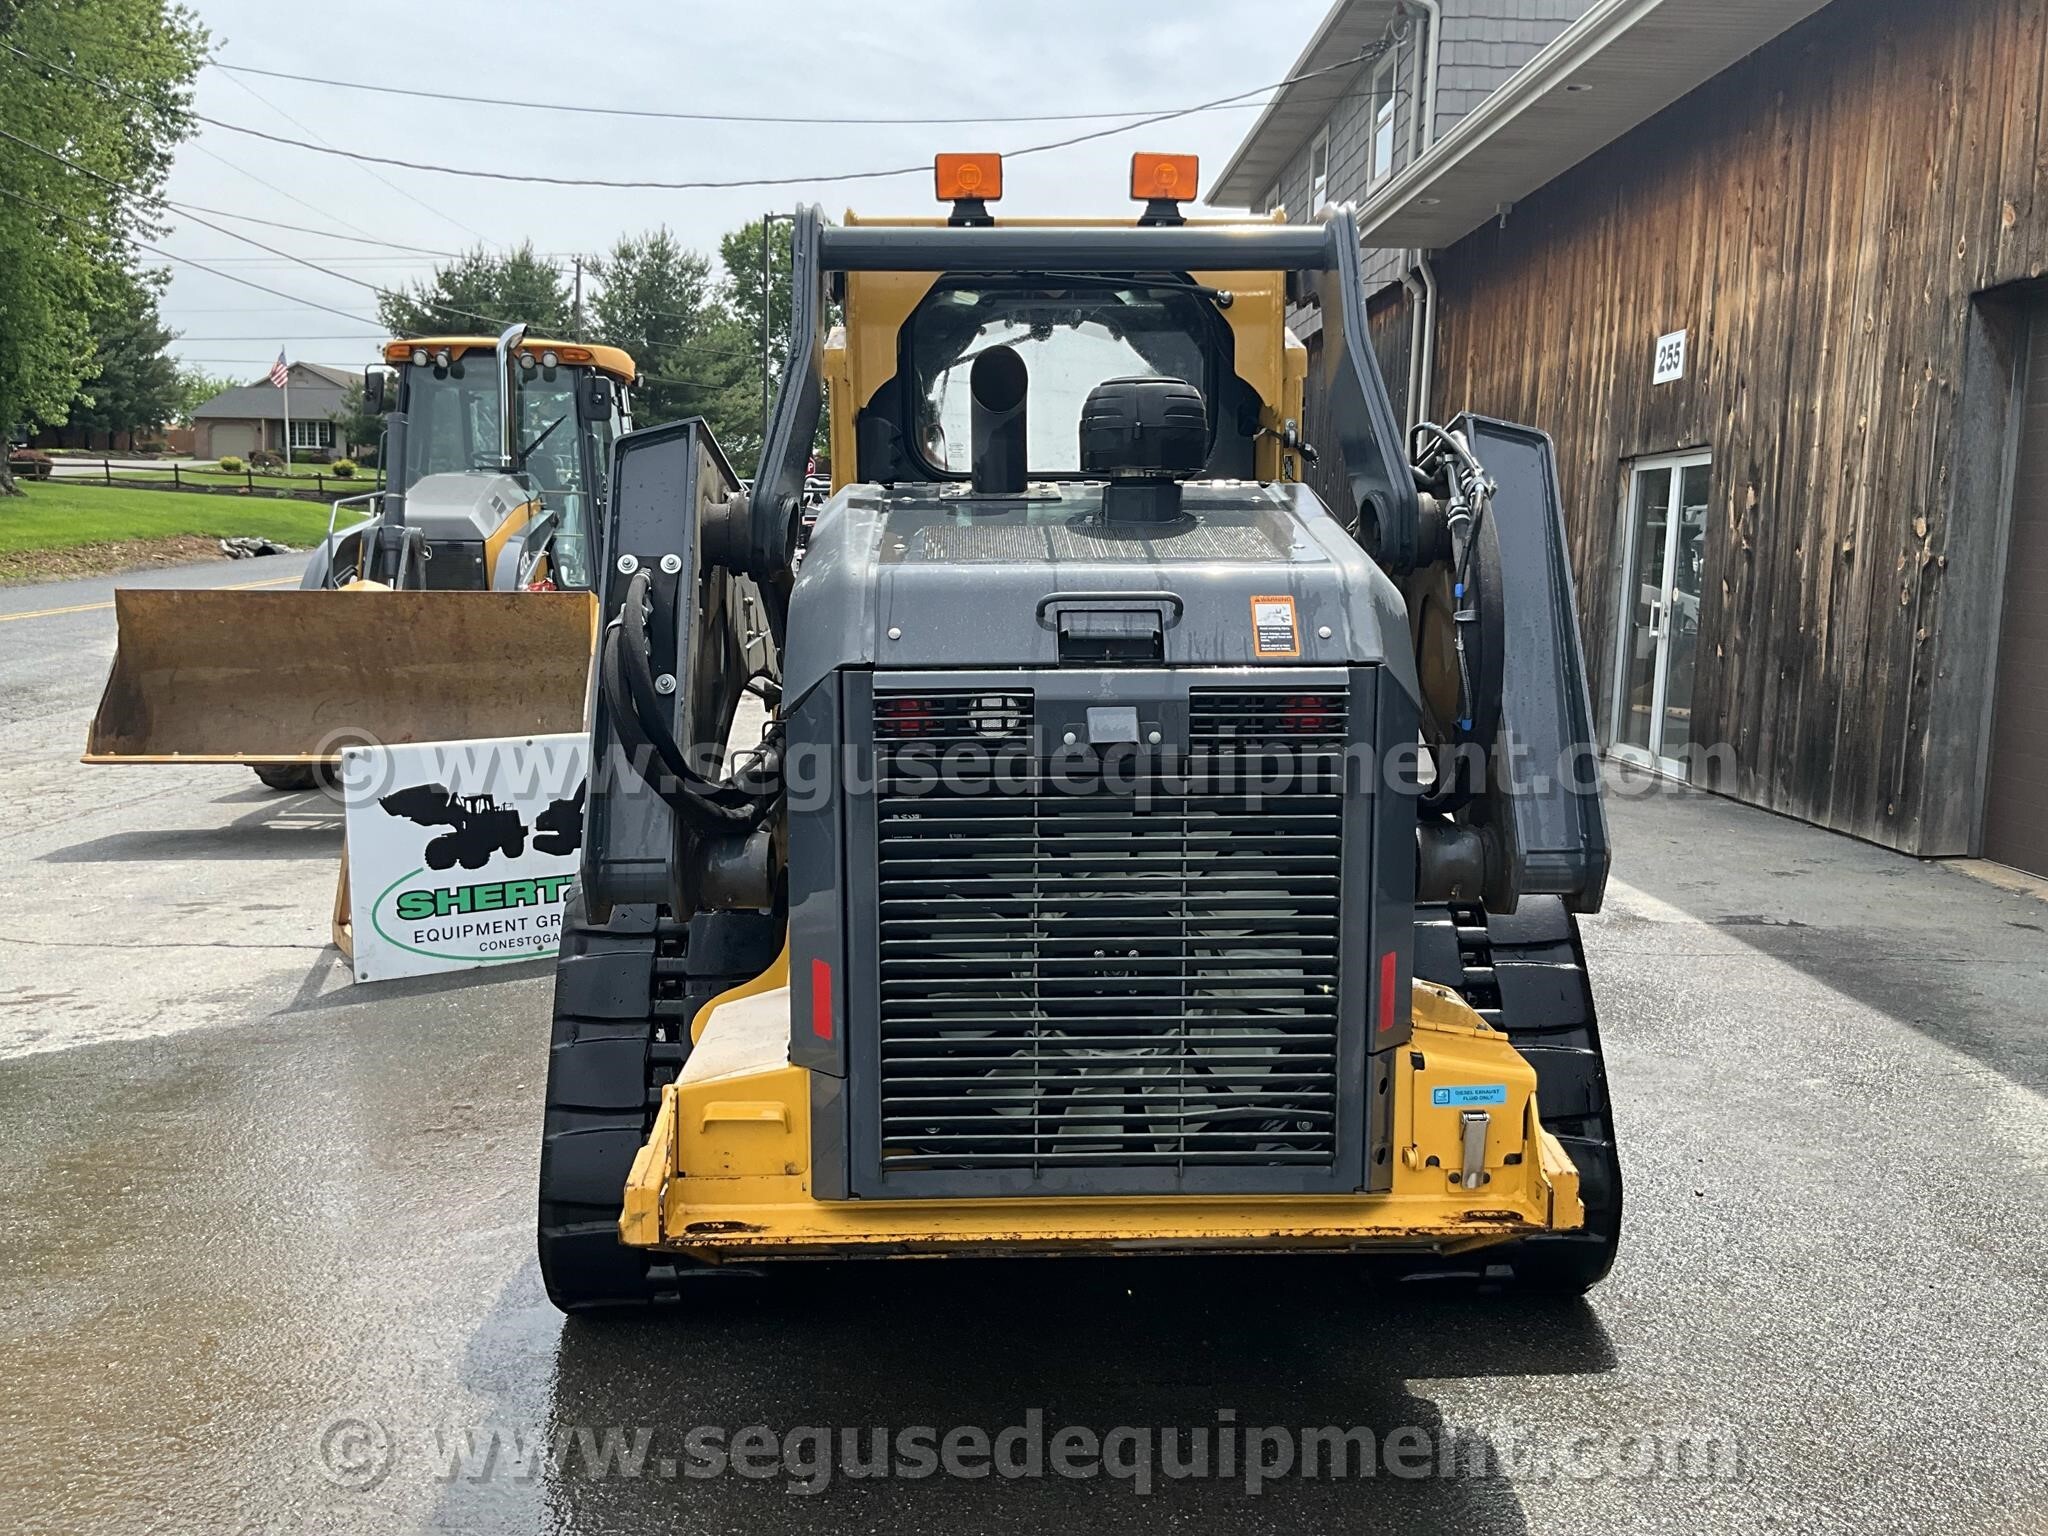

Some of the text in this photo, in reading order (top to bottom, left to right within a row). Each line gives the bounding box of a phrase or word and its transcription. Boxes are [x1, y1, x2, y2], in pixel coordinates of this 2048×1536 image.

[1658, 341, 1681, 373] 255
[414, 917, 528, 943] EQUIPMENT
[479, 932, 560, 952] CONESTOGA
